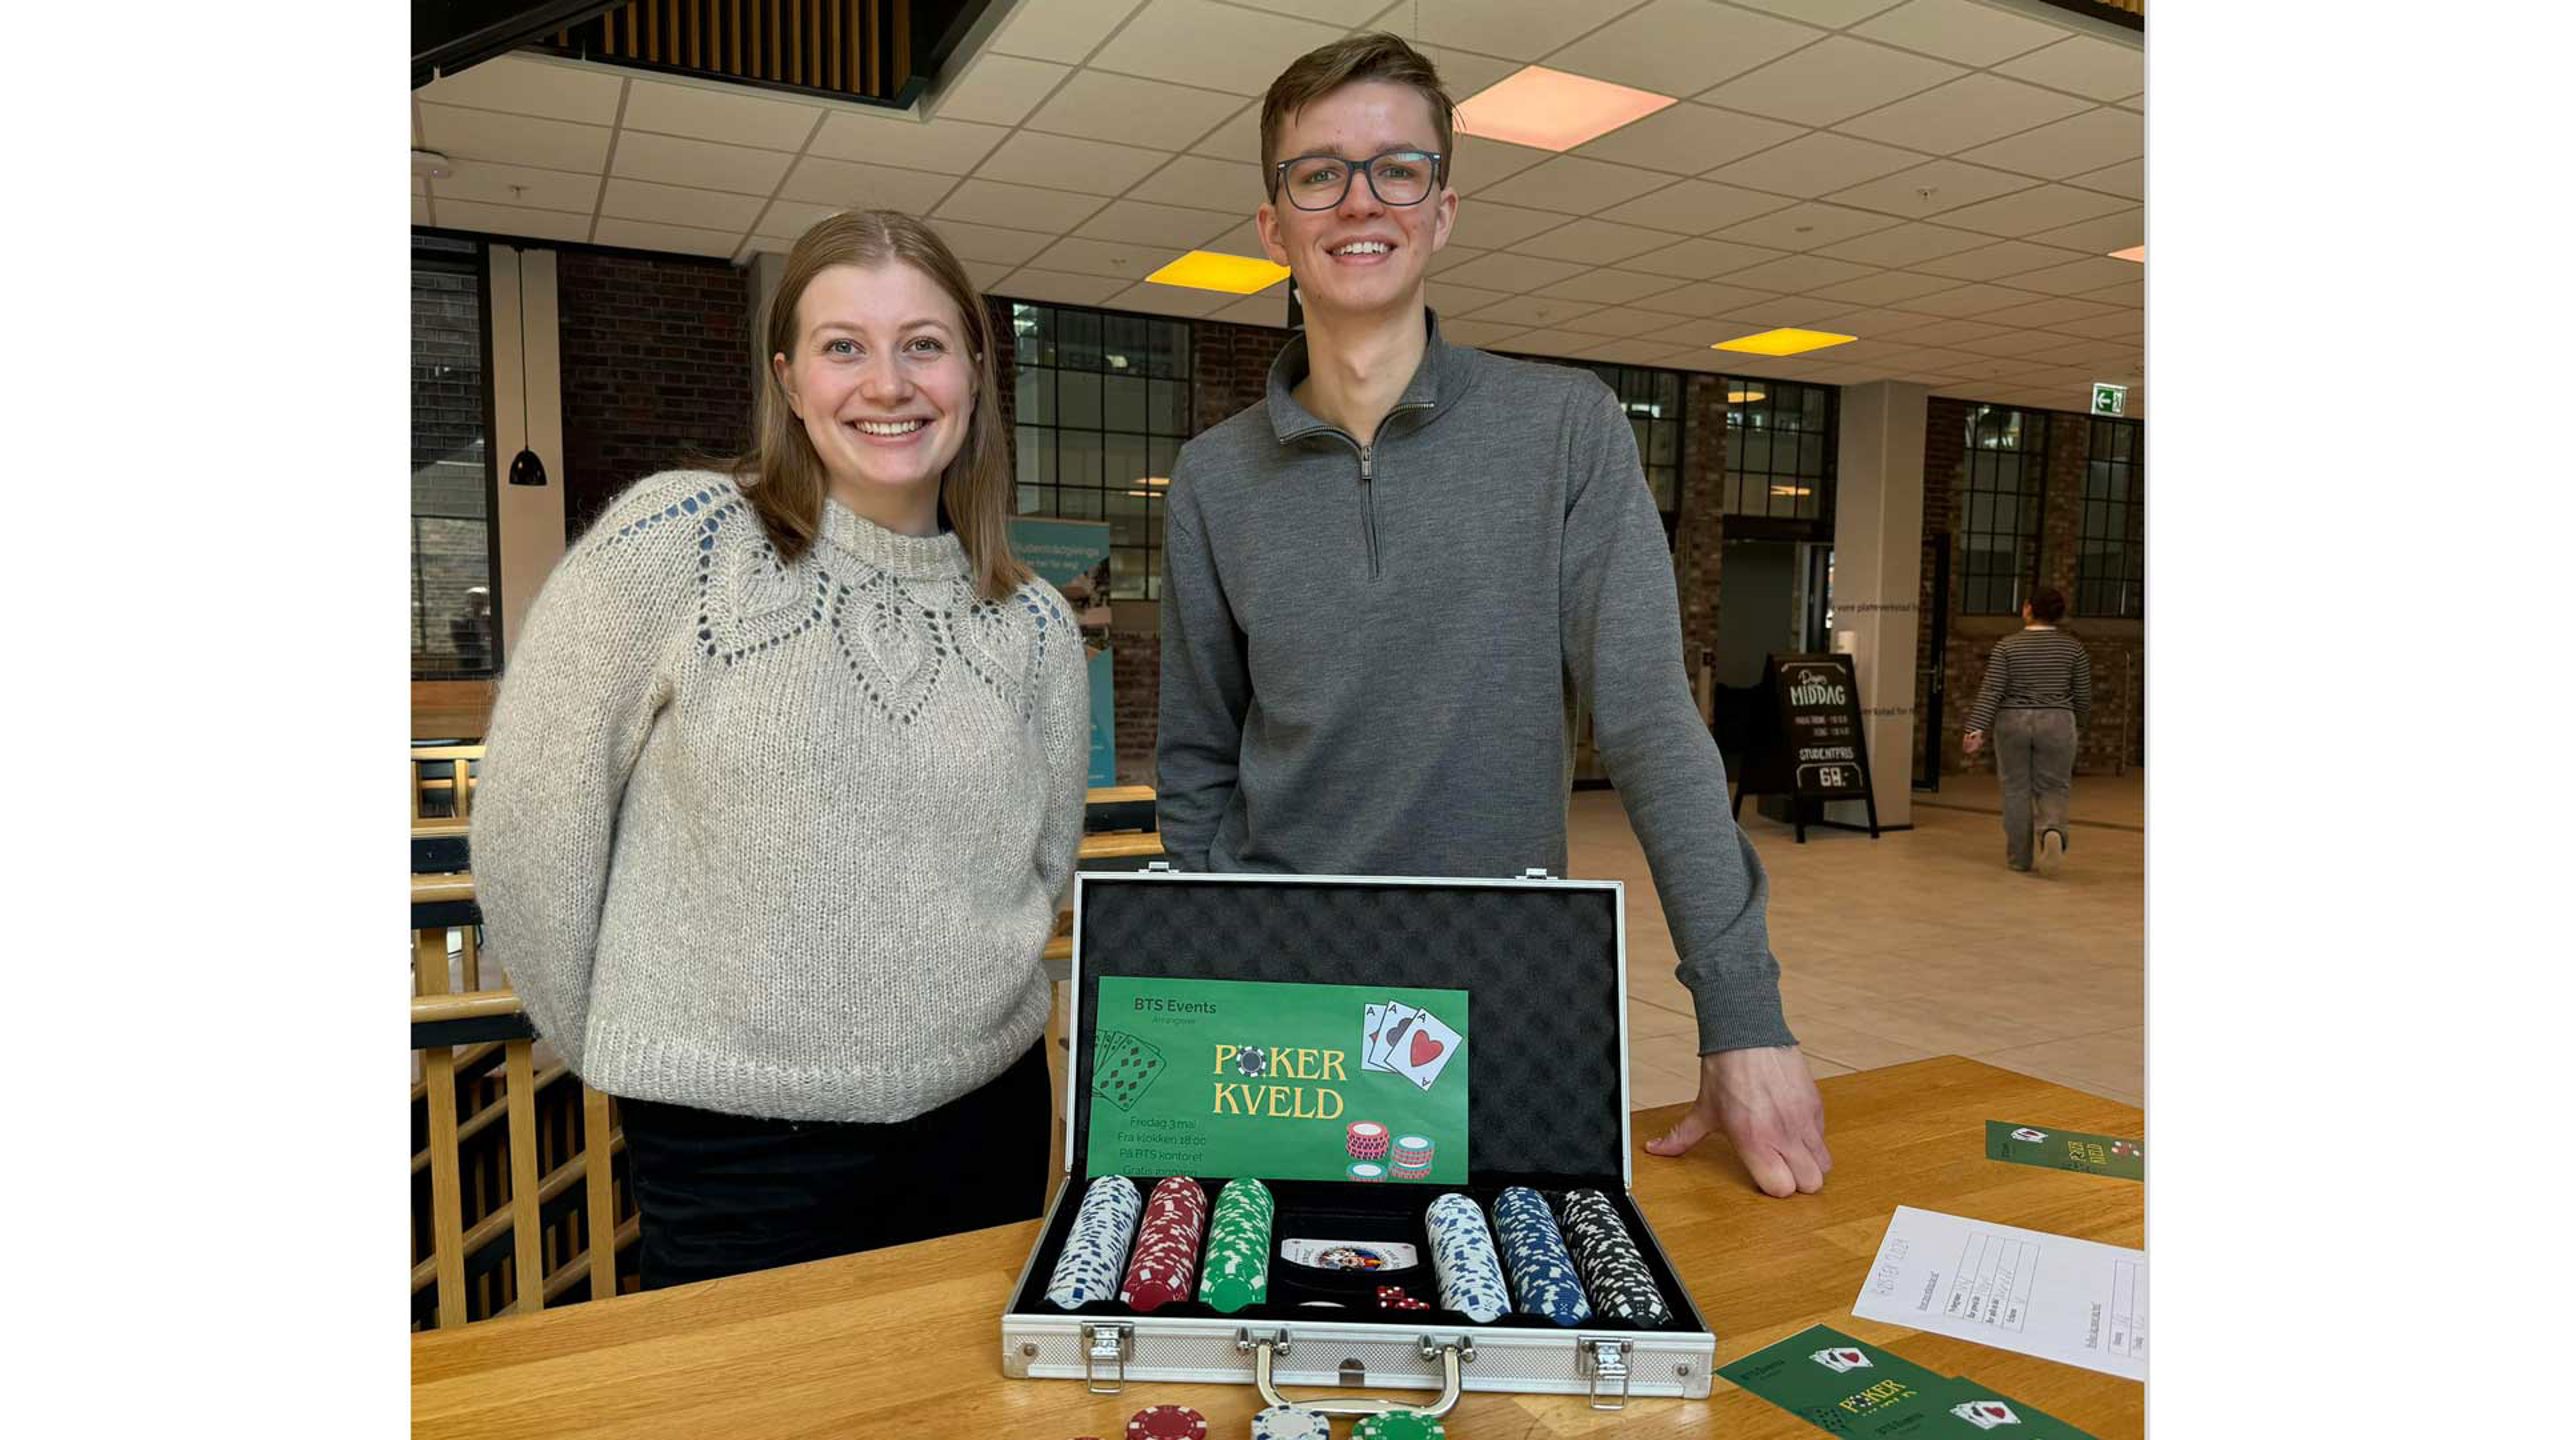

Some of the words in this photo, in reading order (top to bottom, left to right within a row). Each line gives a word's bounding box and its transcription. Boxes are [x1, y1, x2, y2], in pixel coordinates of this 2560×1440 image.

[1790, 685, 1846, 706] MIDDAG
[1134, 998, 1163, 1012] BTS
[1167, 999, 1217, 1014] Events
[1213, 1044, 1348, 1081] POKER
[1212, 1082, 1344, 1120] KVELD
[1130, 1117, 1167, 1129] Fredag
[1118, 1131, 1135, 1142] Fra
[1136, 1133, 1177, 1145] klokken
[1119, 1147, 1133, 1159] På
[1135, 1149, 1157, 1160] BTS
[1158, 1150, 1202, 1162] kontoret
[1122, 1165, 1153, 1176] Gratis
[1839, 1378, 1907, 1414] POKER
